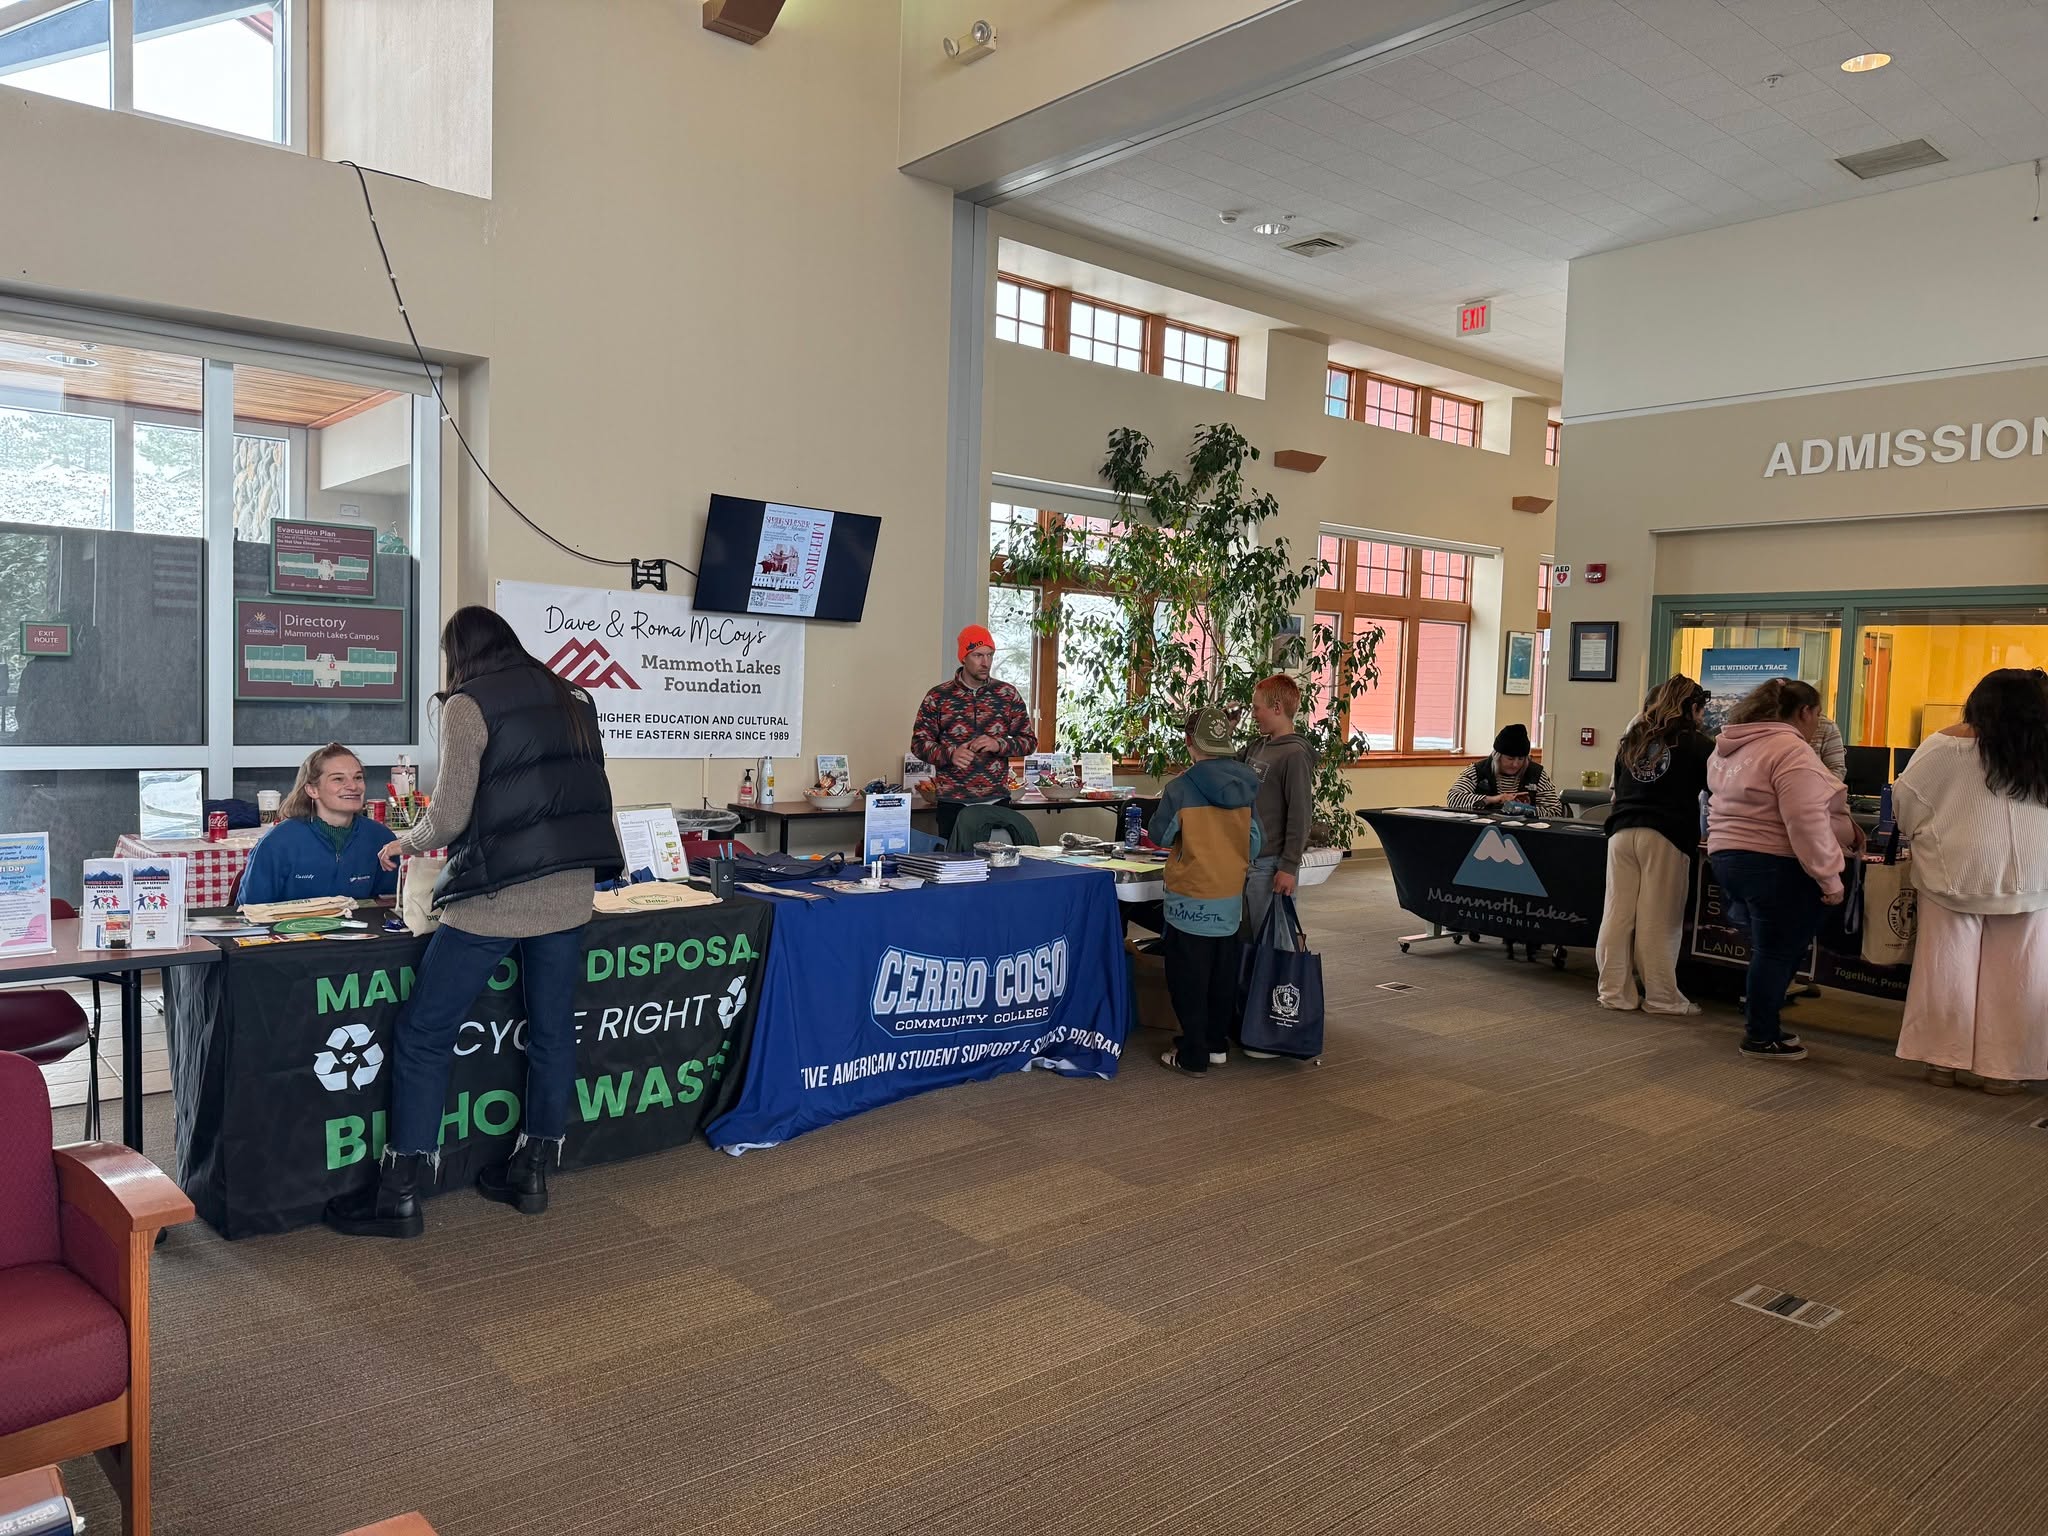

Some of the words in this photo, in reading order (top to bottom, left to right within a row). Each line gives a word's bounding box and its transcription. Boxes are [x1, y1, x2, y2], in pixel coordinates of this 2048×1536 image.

[1462, 304, 1487, 331] EXIT
[277, 526, 318, 536] Evacuation
[320, 529, 336, 537] Plan
[802, 522, 826, 590] MEETINGS
[1555, 565, 1570, 573] AED
[284, 614, 347, 630] Directory
[544, 605, 601, 634] Dave
[605, 610, 624, 638] &
[631, 611, 686, 639] Roma
[690, 616, 767, 657] McCoy's
[284, 629, 324, 639] Mammoth
[326, 632, 348, 640] Lakes
[349, 633, 380, 641] Campus
[641, 654, 734, 673] Mammoth
[736, 659, 782, 675] Lakes
[664, 677, 763, 694] Foundation
[597, 712, 642, 724] HIGHER
[645, 714, 710, 725] EDUCATION
[712, 715, 735, 725] AND
[737, 716, 789, 726] CULTURAL
[609, 729, 633, 739] THE
[637, 730, 690, 740] EASTERN
[693, 731, 733, 740] SIERRA
[735, 731, 766, 741] SINCE
[769, 731, 790, 741] 1989
[1427, 887, 1522, 915] Mammoth
[1525, 901, 1588, 923] Lakes
[1458, 909, 1541, 929] CALIFORNIA
[587, 933, 760, 982] DISPOSA
[1702, 939, 1746, 958] LAND
[872, 948, 990, 1016] CERRO
[995, 937, 1069, 1008] COSO
[597, 994, 711, 1041] RIGHT
[895, 1014, 989, 1031] COMMUNITY
[994, 1007, 1050, 1024] COLLEGE
[832, 1051, 897, 1086] AMERICAN
[897, 1045, 960, 1070] STUDENT
[961, 1040, 1020, 1064] SUPPORT
[1018, 1039, 1031, 1053] &
